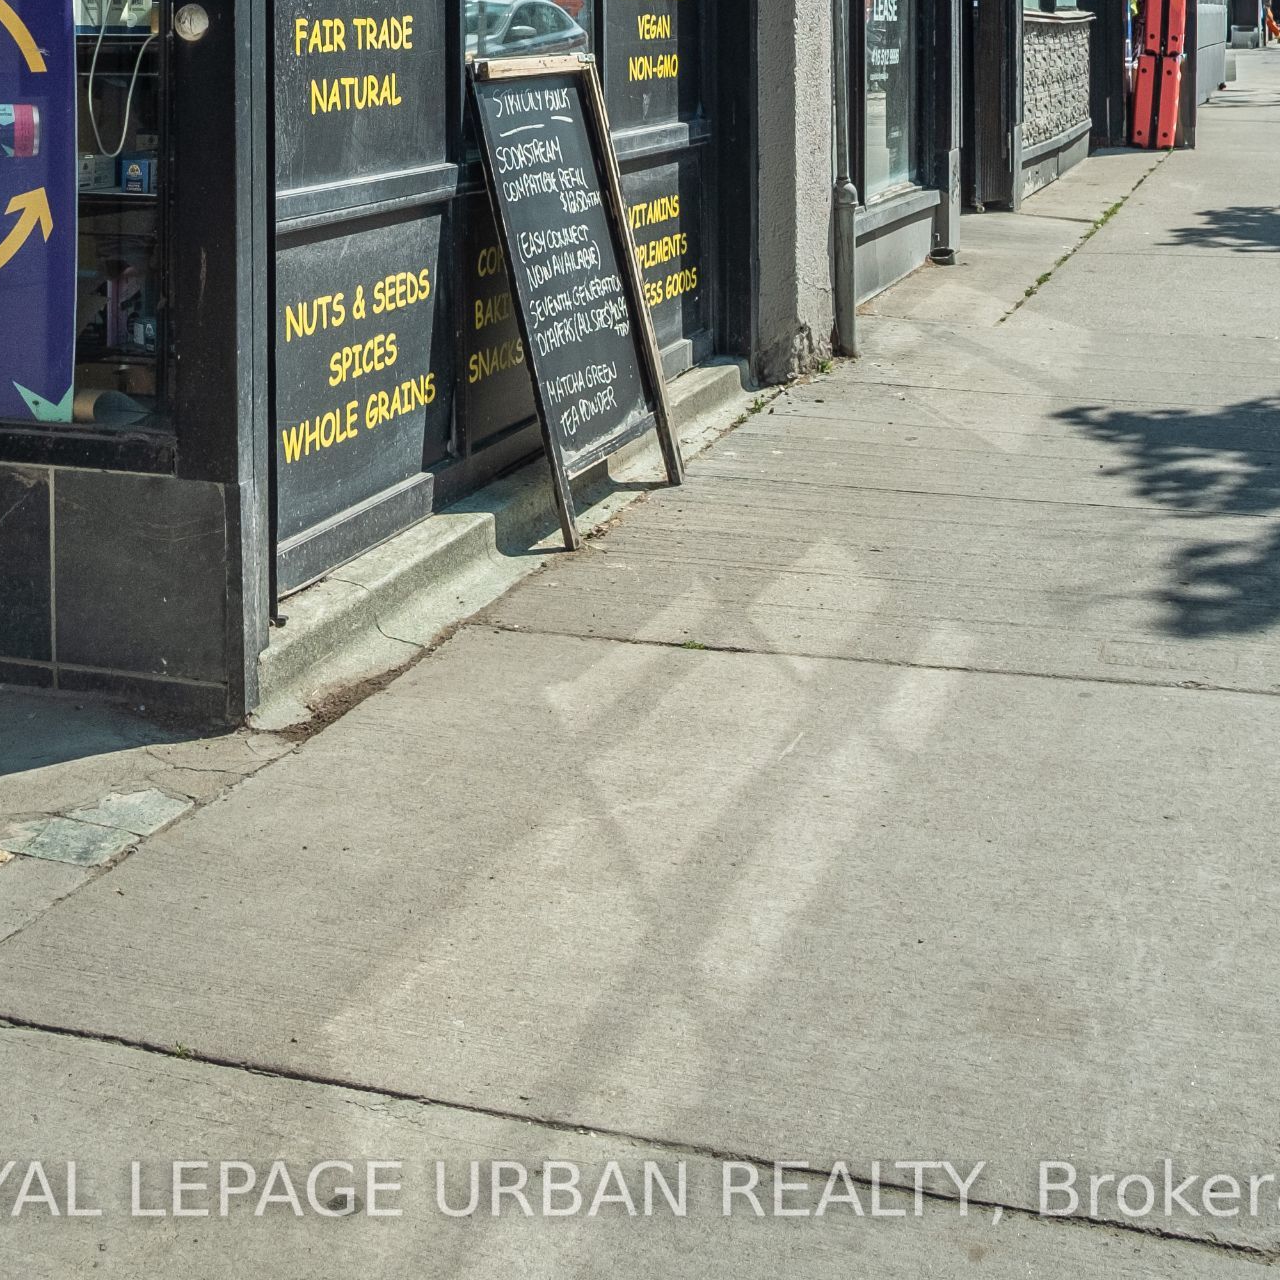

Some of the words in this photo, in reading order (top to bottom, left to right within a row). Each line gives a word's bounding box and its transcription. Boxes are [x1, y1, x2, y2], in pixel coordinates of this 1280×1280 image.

[295, 17, 349, 56] FAIR
[353, 16, 414, 51] TRADE
[637, 14, 671, 40] VEGAN
[629, 53, 679, 82] NON-GMO
[310, 73, 402, 115] NATURAL
[544, 87, 570, 111] BULK
[495, 136, 564, 174] SODASTREAM
[628, 194, 680, 231] VITAMINS
[546, 224, 590, 251] CONNECT
[526, 262, 553, 292] NOW
[666, 267, 697, 300] GOODS
[284, 293, 345, 342] NUTS
[353, 284, 367, 320] &
[372, 268, 431, 314] SEEDS
[529, 290, 573, 329] SEVENTH
[536, 317, 576, 357] DIAPERS
[328, 332, 398, 388] SPICES
[469, 336, 525, 383] SNACKS
[545, 373, 585, 407] MATCHA
[585, 361, 618, 389] GREEN
[282, 400, 359, 464] WHOLE
[365, 372, 436, 431] GRAINS
[559, 410, 579, 438] TEA
[579, 385, 618, 422] POWDER
